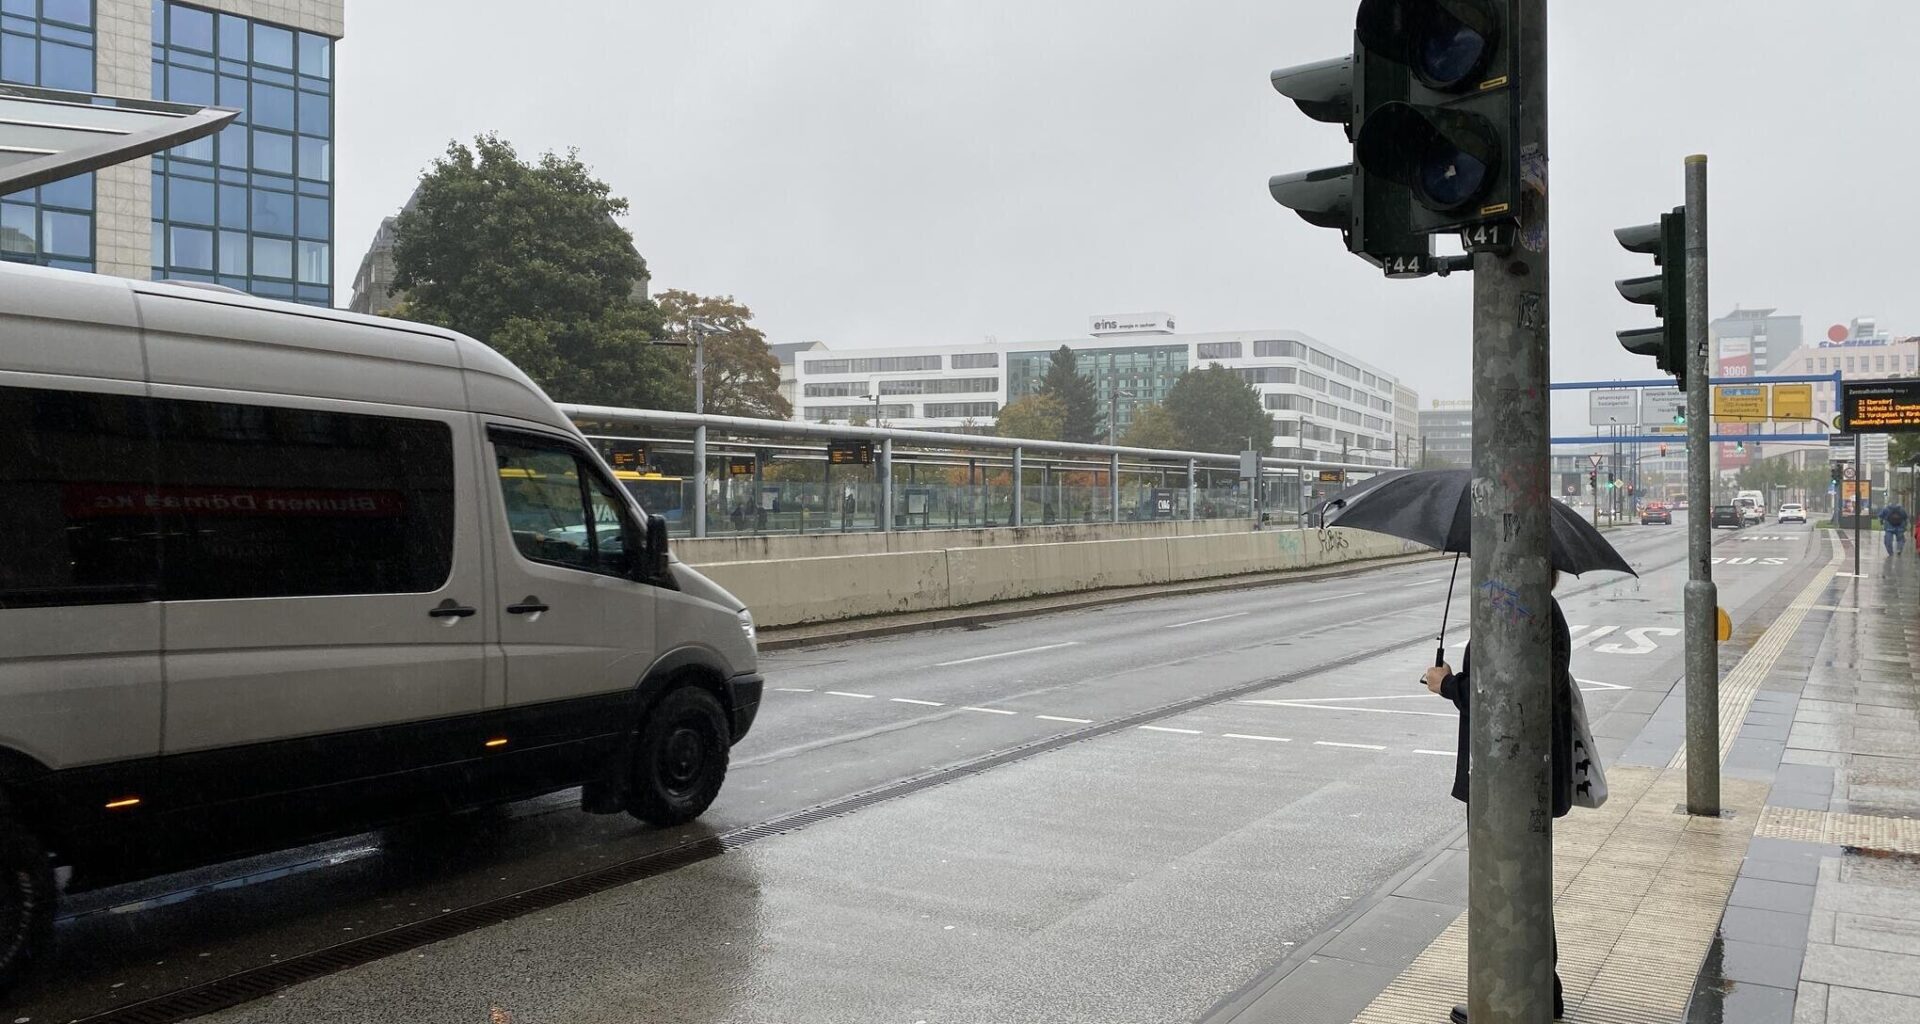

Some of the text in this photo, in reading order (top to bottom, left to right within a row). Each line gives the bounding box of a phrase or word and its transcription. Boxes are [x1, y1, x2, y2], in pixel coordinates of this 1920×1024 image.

[1463, 225, 1498, 247] K41
[1094, 319, 1117, 330] eins
[1723, 366, 1747, 376] 3000
[1158, 500, 1170, 509] CVAG
